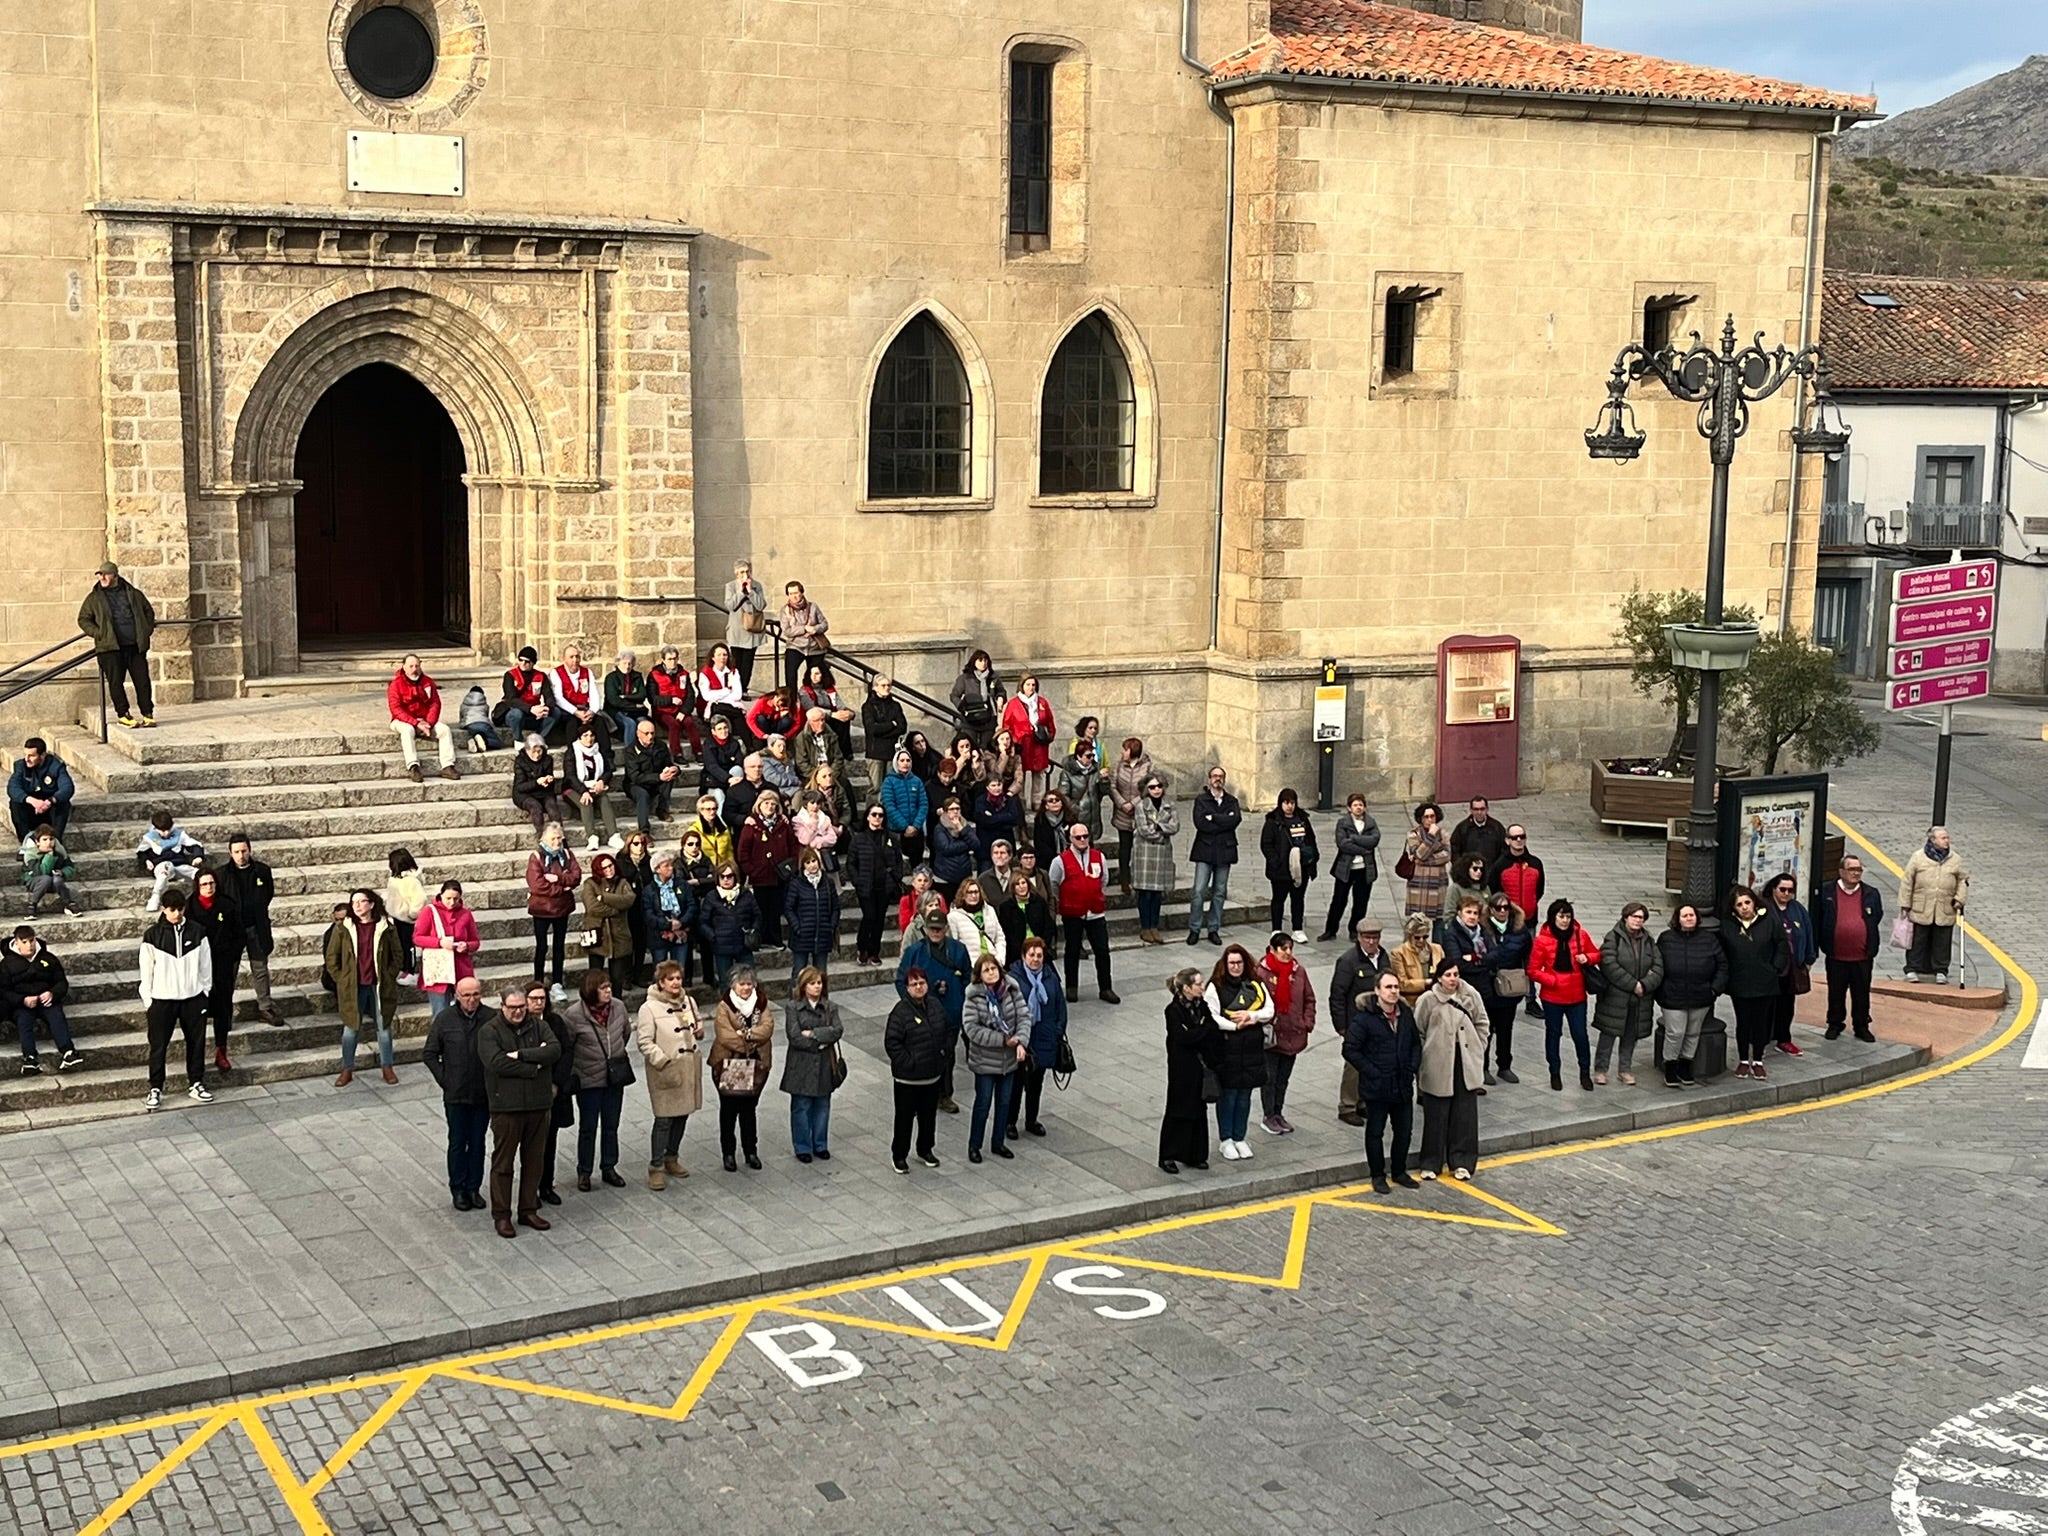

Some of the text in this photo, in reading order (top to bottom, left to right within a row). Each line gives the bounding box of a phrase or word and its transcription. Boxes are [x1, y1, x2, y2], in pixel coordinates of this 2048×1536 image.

[1946, 609, 1954, 617] de
[1745, 801, 1810, 815] Teatro Cervantes
[746, 1264, 1168, 1389] BUS
